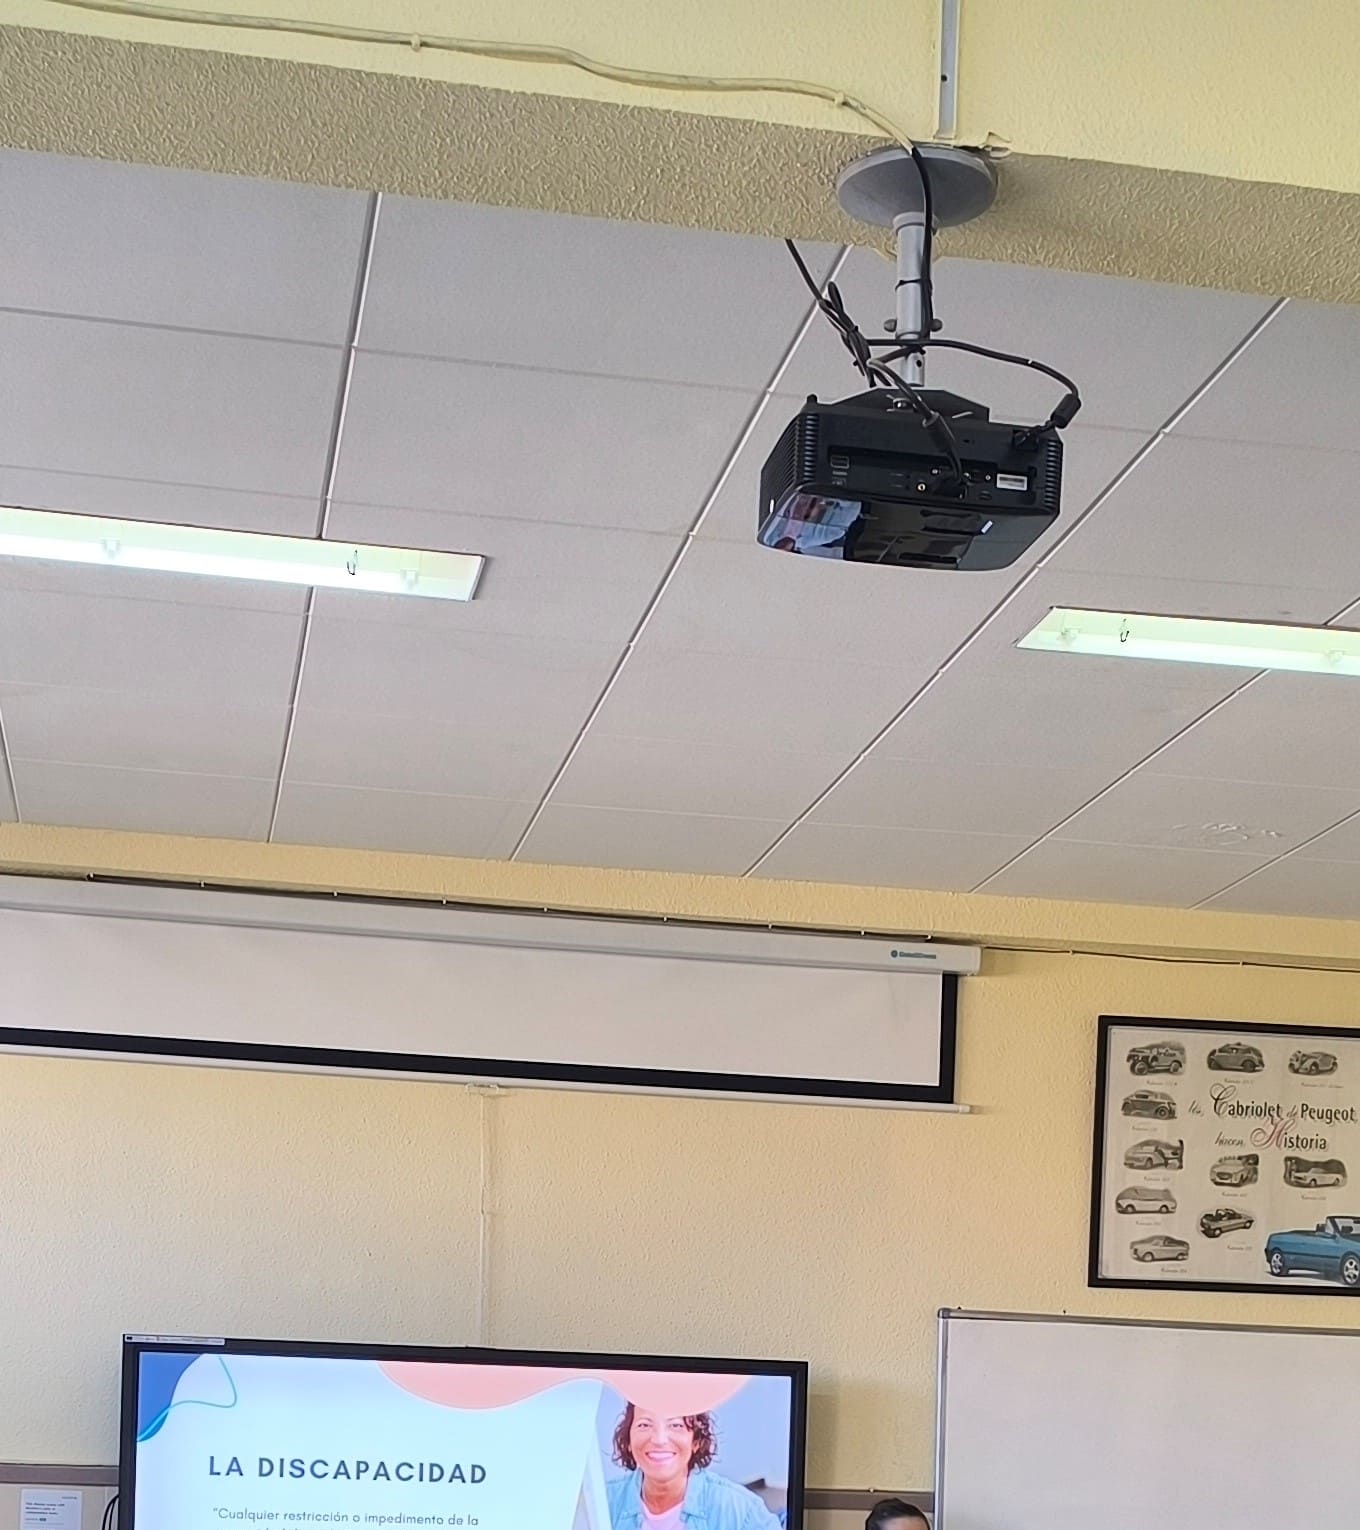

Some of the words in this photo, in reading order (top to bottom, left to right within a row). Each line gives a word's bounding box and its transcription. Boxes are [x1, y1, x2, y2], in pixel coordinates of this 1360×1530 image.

[1209, 1083, 1283, 1118] Cabriolet
[1300, 1103, 1356, 1124] Peugeot
[1250, 1115, 1328, 1151] Historia
[208, 1455, 244, 1477] LA
[258, 1457, 487, 1484] DISCAPACIDAD
[283, 1510, 349, 1523] restricción
[352, 1514, 361, 1523] o
[364, 1512, 444, 1526] impedimento
[448, 1513, 464, 1526] de
[467, 1514, 480, 1526] la
